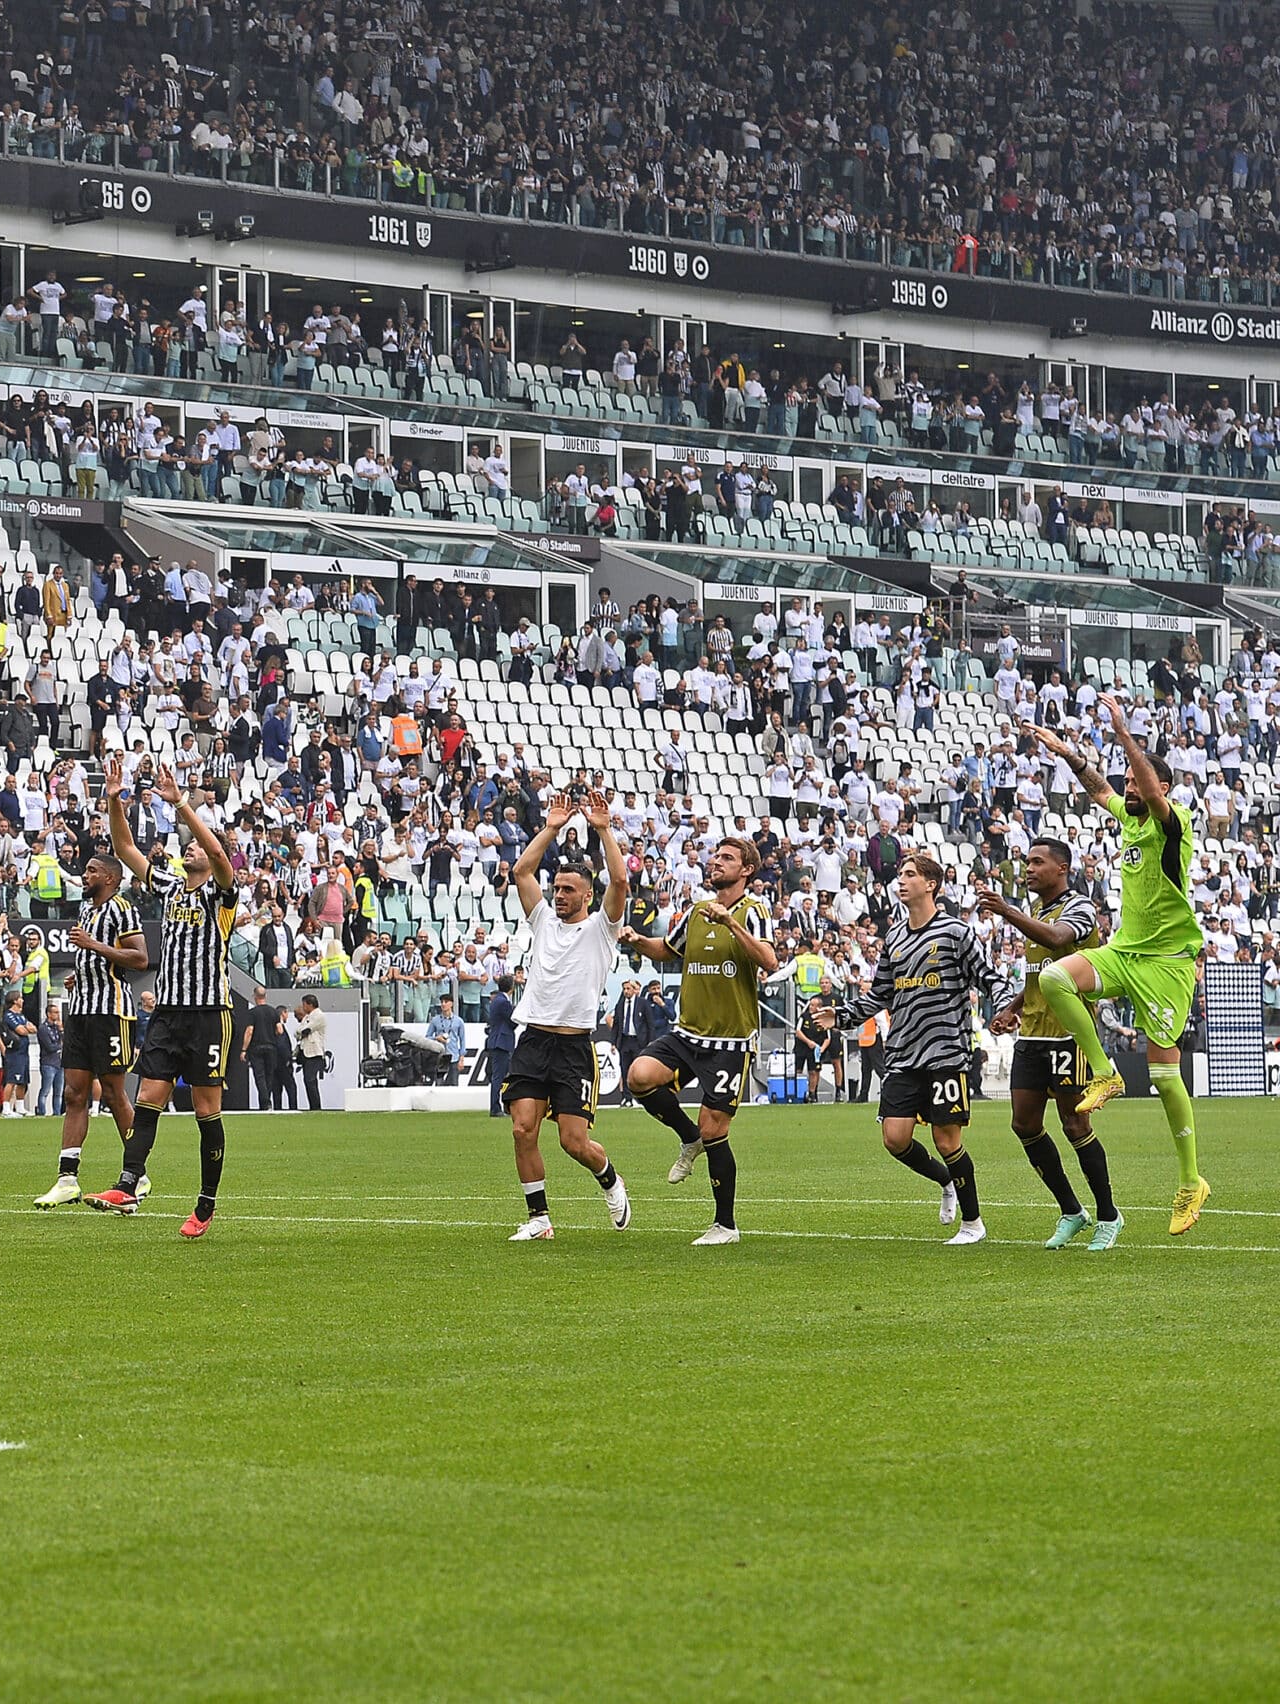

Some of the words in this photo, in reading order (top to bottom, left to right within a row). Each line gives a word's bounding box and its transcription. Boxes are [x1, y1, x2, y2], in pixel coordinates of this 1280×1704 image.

[369, 215, 410, 246] 1961
[418, 227, 430, 241] 12
[628, 246, 667, 275] 1960
[891, 279, 926, 307] 1959
[1150, 309, 1208, 335] Allianz
[1237, 317, 1280, 340] Stadi
[418, 427, 444, 436] finder
[561, 437, 600, 452] JUVENTUS
[742, 453, 778, 468] JUVENTUS
[941, 472, 986, 488] deltatre
[1081, 484, 1106, 498] nexi
[40, 502, 82, 517] Stadium
[550, 540, 581, 553] Stadium
[453, 569, 480, 580] Allianz
[721, 586, 760, 601] JUVENTUS
[872, 596, 908, 611] JUVENTUS
[1084, 612, 1119, 626] JUVENTUS
[1145, 616, 1179, 630] JUVENTUS
[1021, 643, 1052, 657] Stadium
[1123, 846, 1144, 866] ep
[170, 902, 204, 927] Jeep
[687, 962, 720, 976] Allianz
[895, 976, 924, 989] Allianz
[109, 1036, 121, 1057] 3
[208, 1045, 220, 1067] 5
[1049, 1051, 1072, 1075] 12
[715, 1070, 741, 1094] 24
[581, 1079, 591, 1101] 11
[932, 1078, 960, 1105] 20
